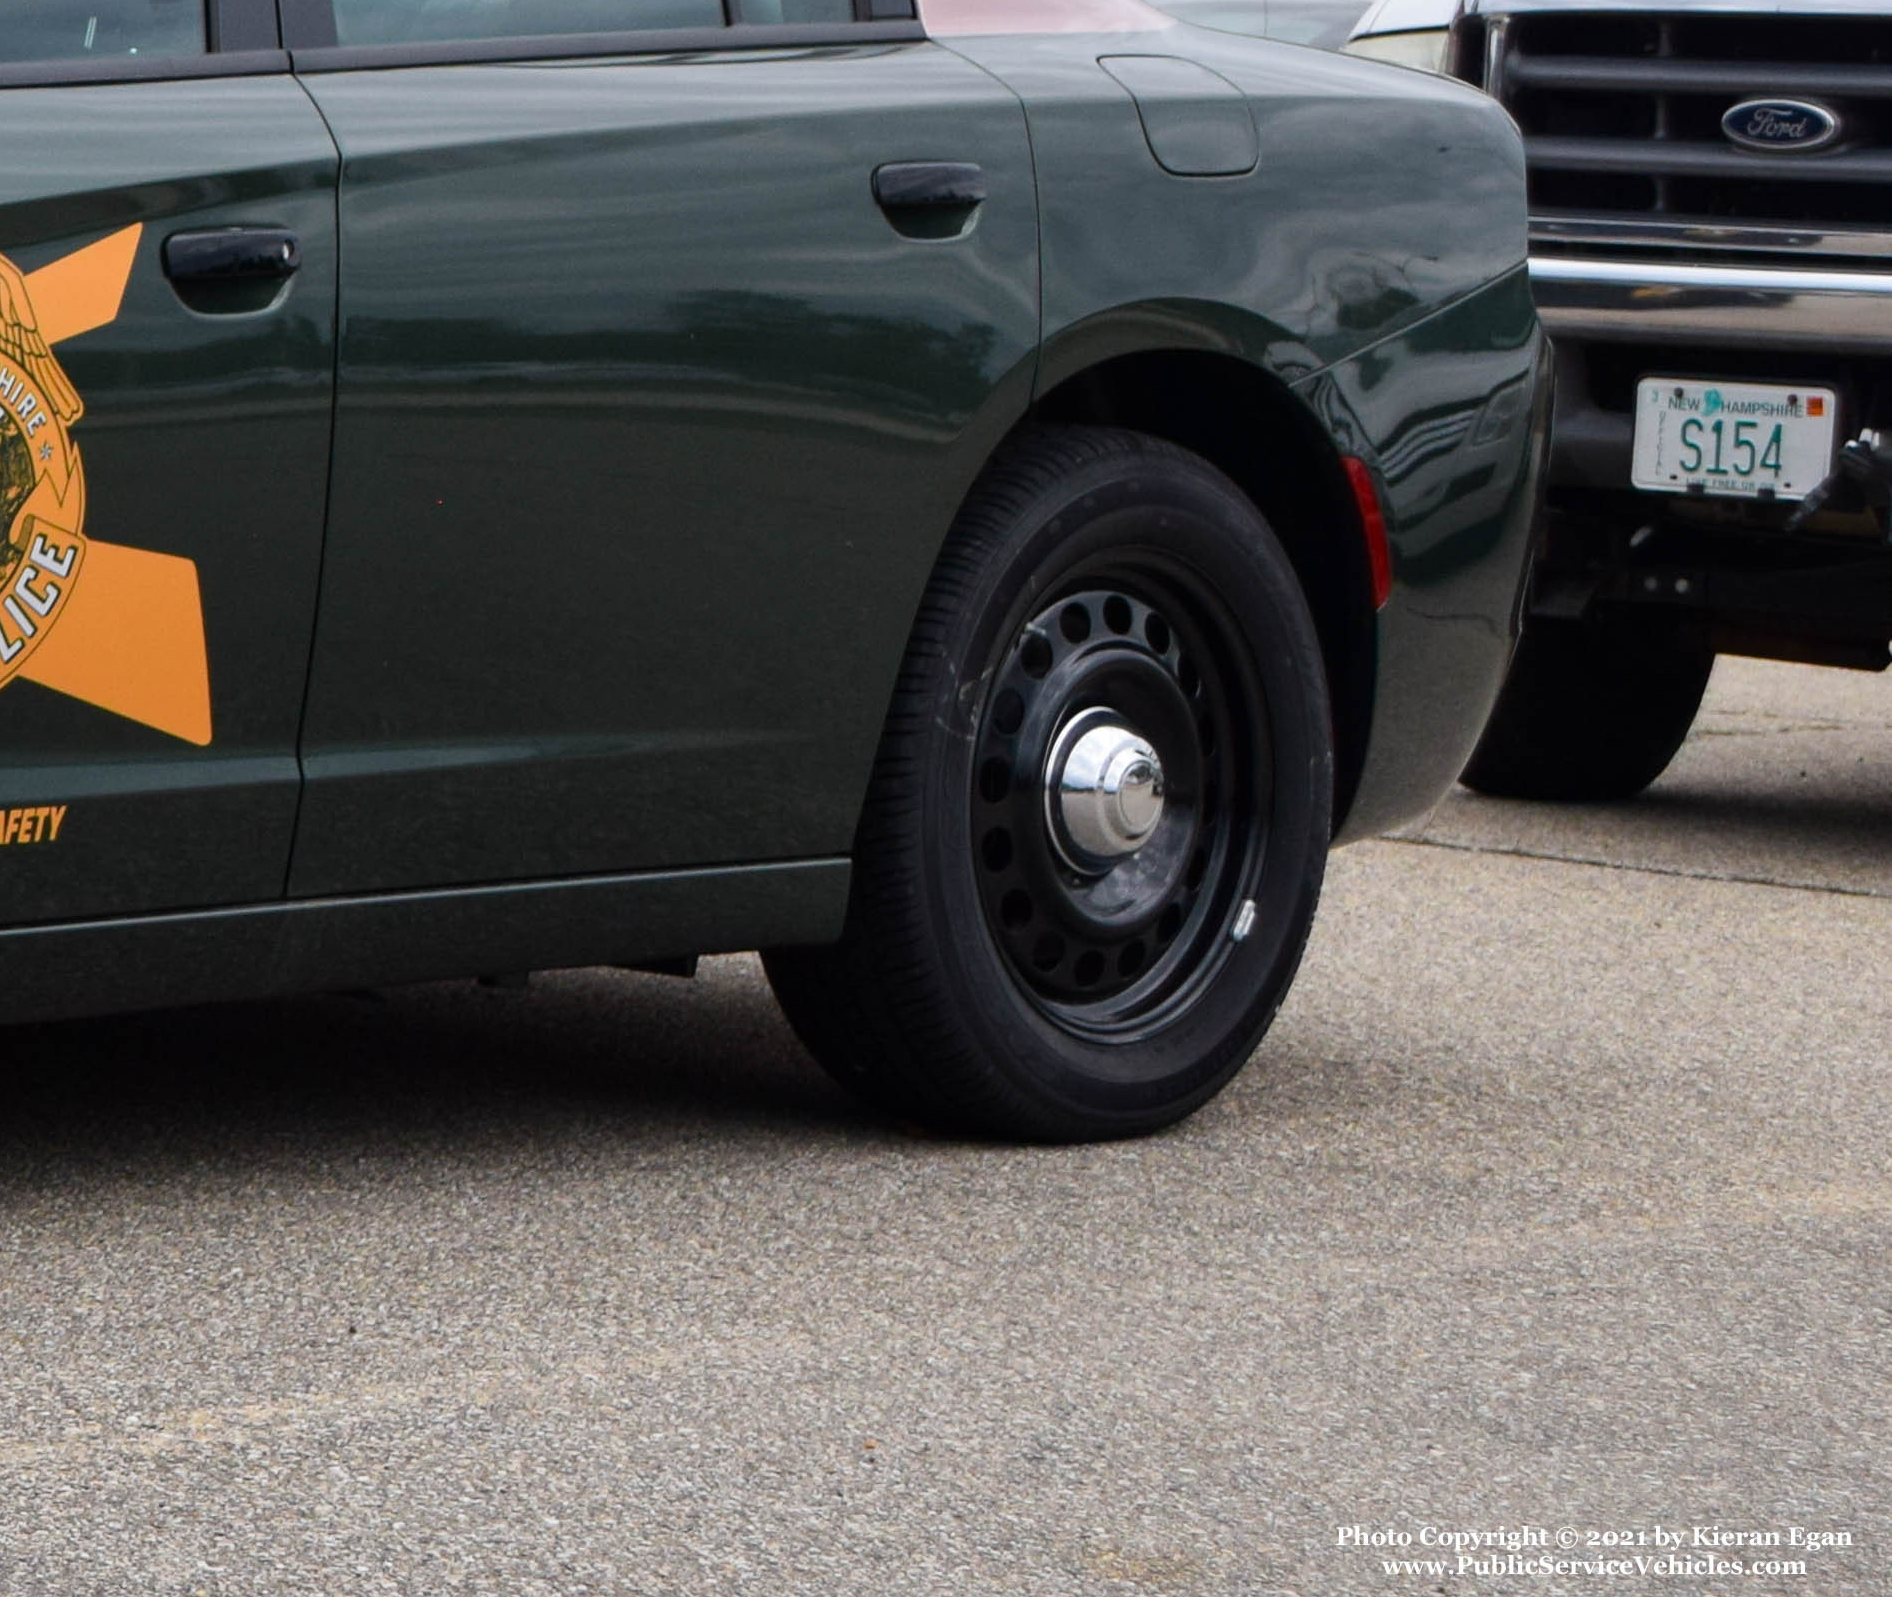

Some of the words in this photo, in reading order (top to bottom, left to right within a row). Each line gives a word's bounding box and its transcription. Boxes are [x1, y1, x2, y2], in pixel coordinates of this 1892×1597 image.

[1746, 107, 1807, 138] Ford
[1668, 396, 1700, 412] NEW
[1720, 399, 1804, 418] HAMPSHIRE
[1679, 417, 1783, 478] S154
